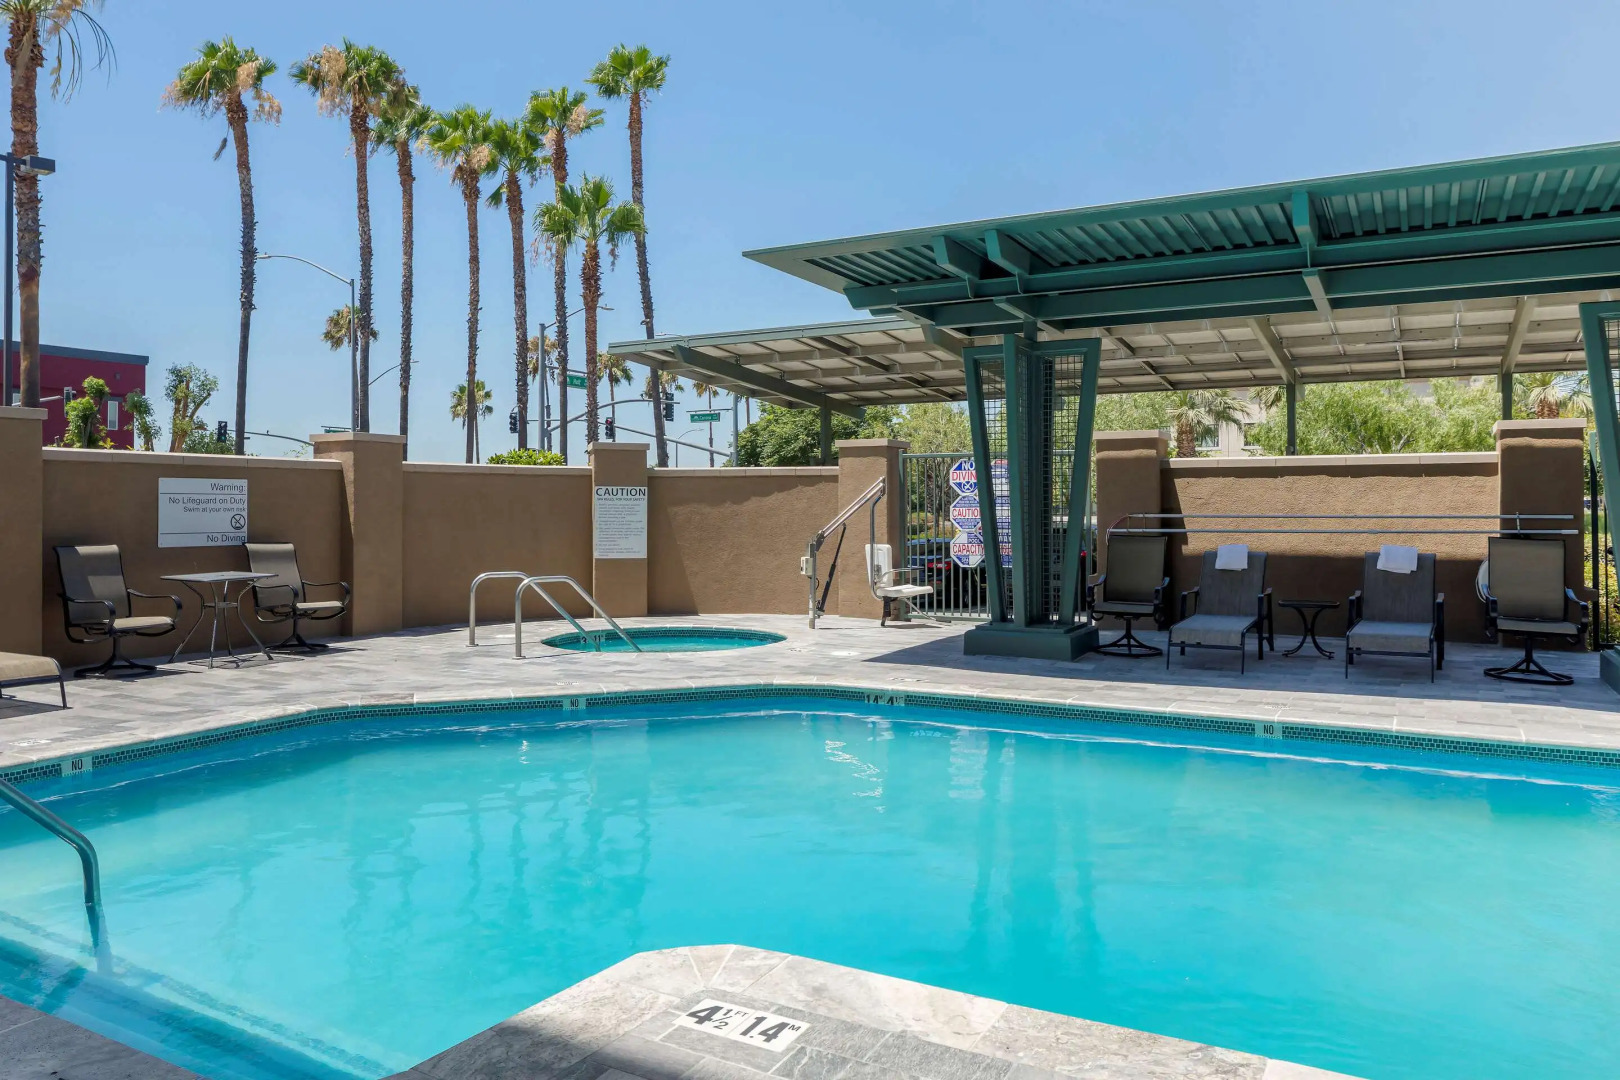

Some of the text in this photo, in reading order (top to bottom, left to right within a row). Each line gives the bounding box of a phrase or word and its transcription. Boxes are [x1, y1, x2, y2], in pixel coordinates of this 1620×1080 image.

[962, 461, 975, 470] NO
[952, 471, 977, 481] DIVIN
[210, 482, 246, 493] Warning:
[596, 488, 646, 496] CAUTION
[168, 496, 180, 504] No
[182, 496, 216, 506] Lifeguard
[230, 496, 246, 506] Duty
[952, 508, 981, 518] CAUTIO
[222, 534, 246, 544] Diving
[952, 544, 985, 554] CAPACITY
[570, 698, 578, 708] NO
[1264, 724, 1274, 734] NO
[72, 758, 82, 771] NO
[734, 1010, 750, 1018] FT
[740, 1016, 802, 1043] 1.4 M
